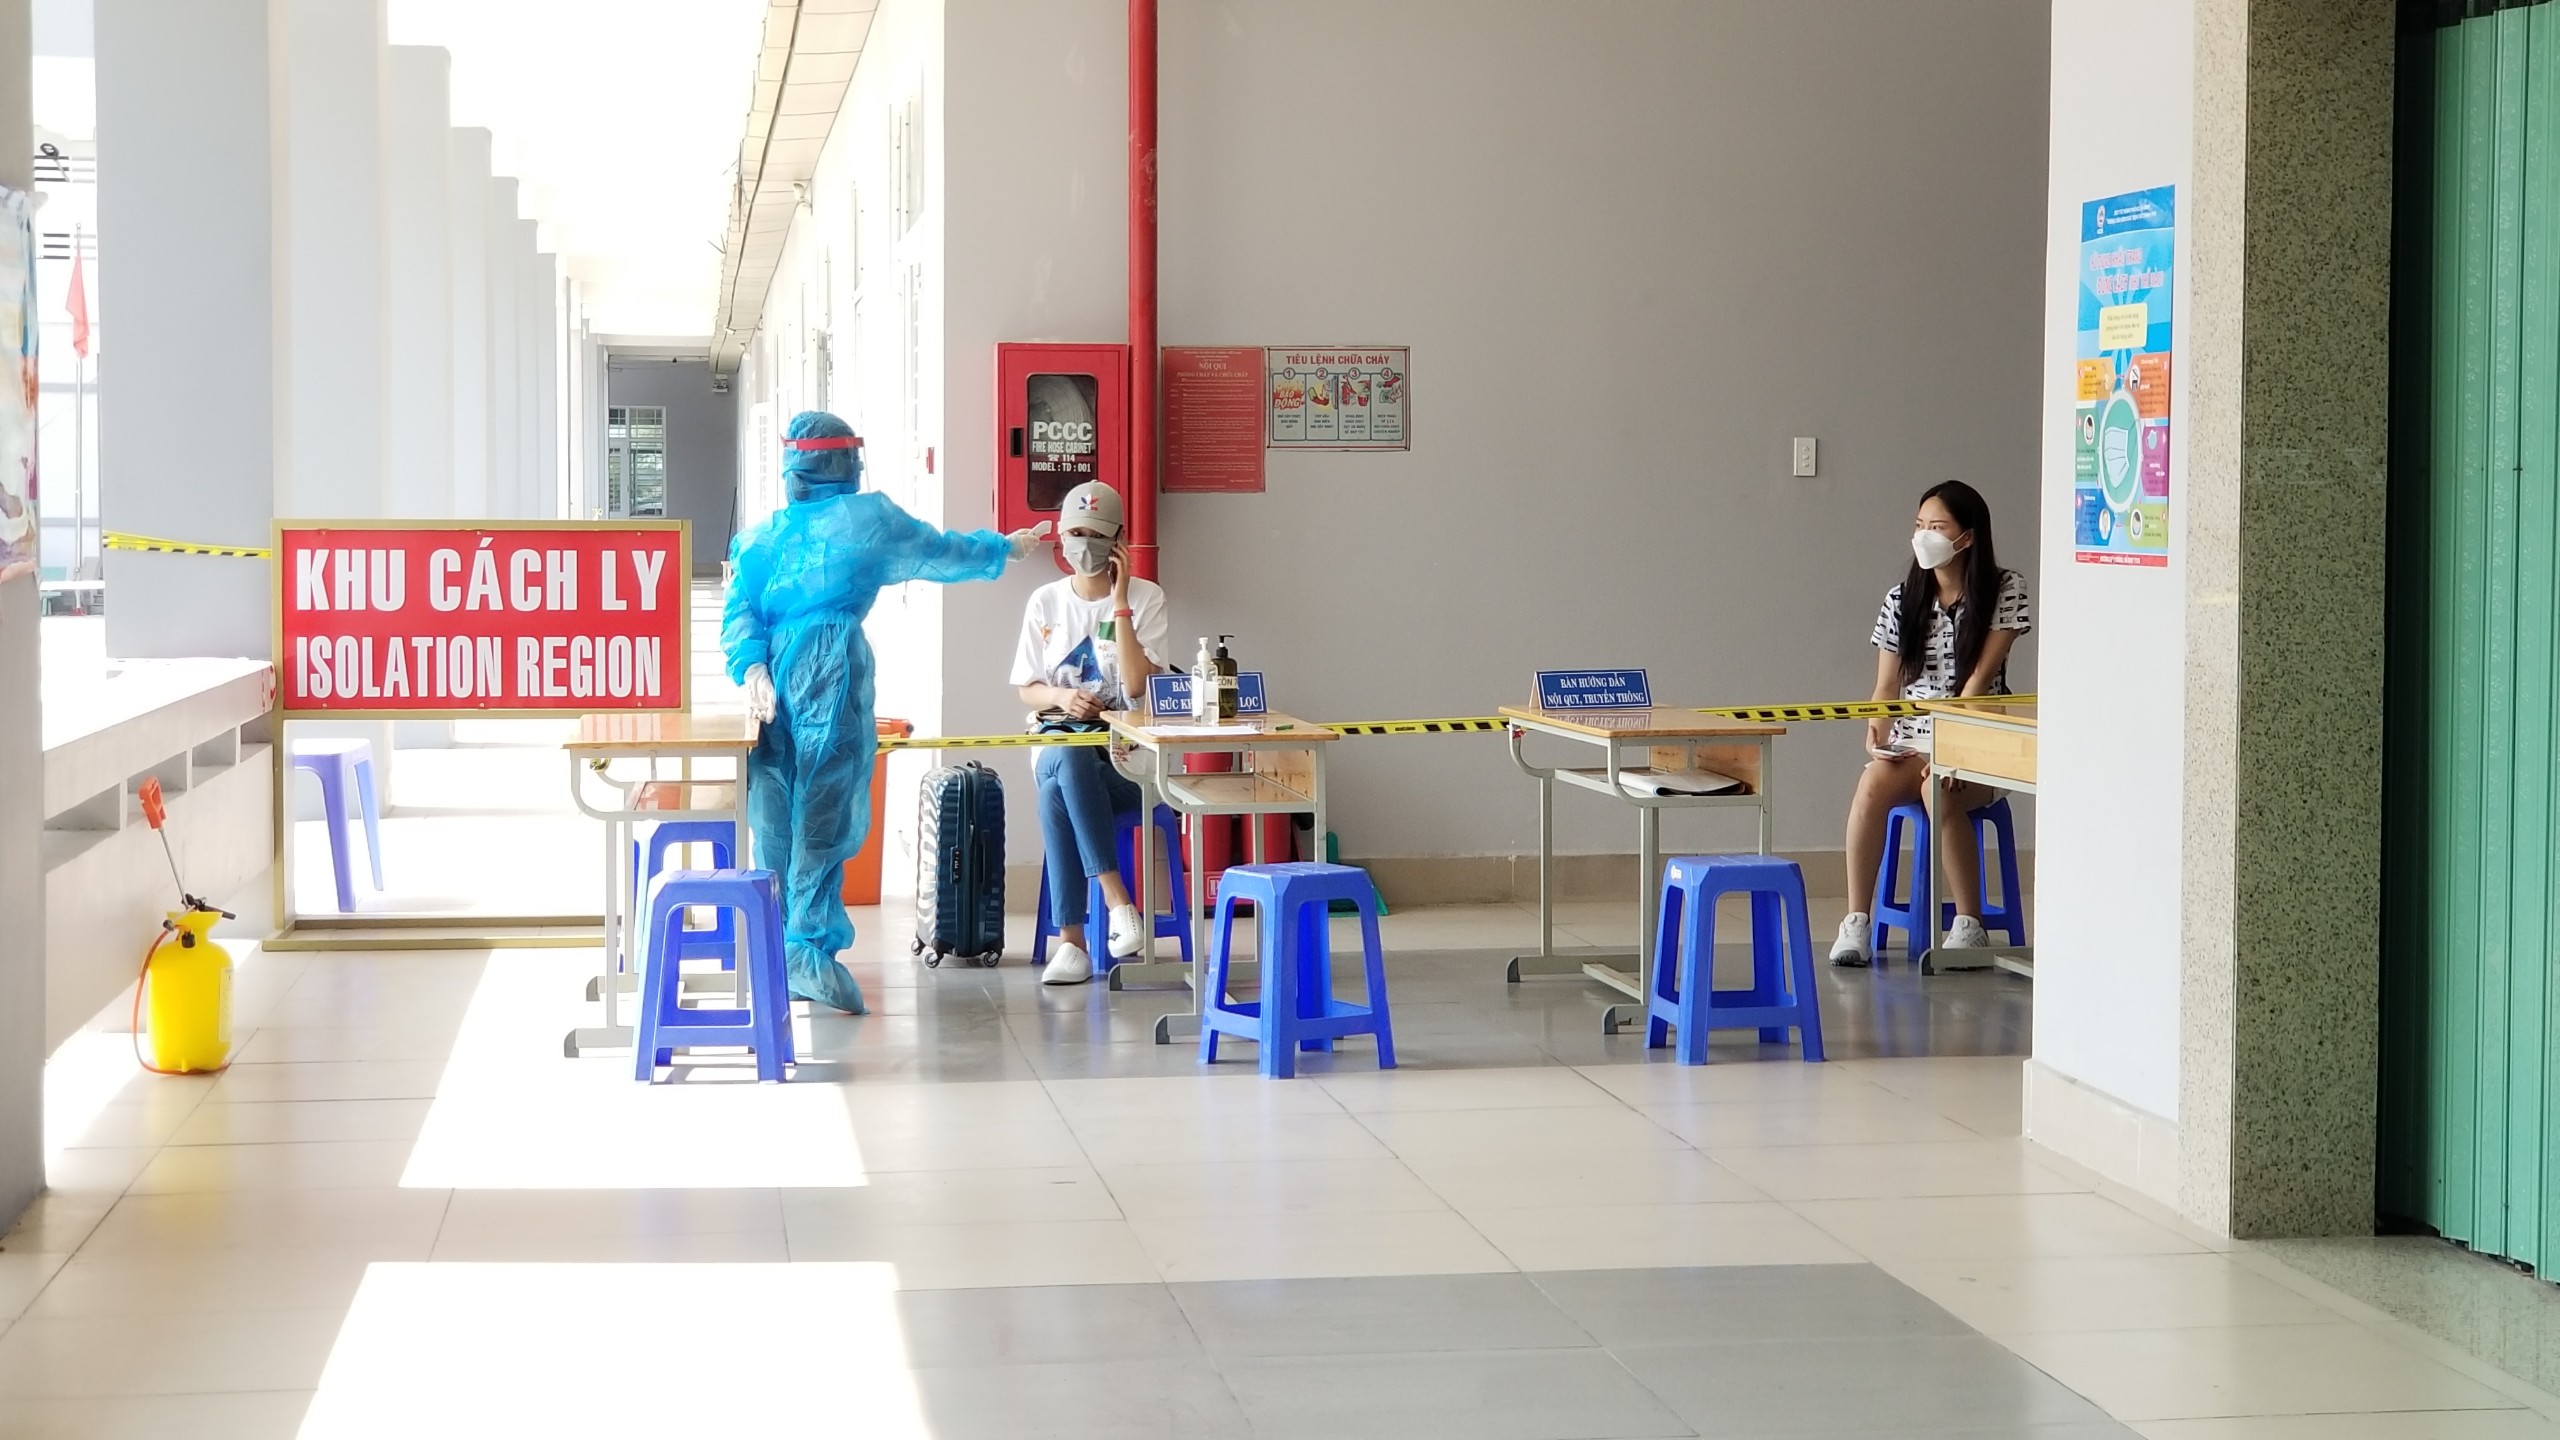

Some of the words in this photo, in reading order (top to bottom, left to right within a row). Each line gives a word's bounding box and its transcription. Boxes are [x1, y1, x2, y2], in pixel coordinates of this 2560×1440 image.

[1286, 353, 1307, 365] TIÊU
[1310, 353, 1335, 366] LỆNH
[1338, 353, 1363, 365] CHỮA
[1365, 353, 1390, 365] CHÁY
[1318, 370, 1325, 378] 2
[1351, 370, 1358, 378] 3
[1383, 370, 1389, 378] 4
[1033, 421, 1093, 441] PCCC
[1032, 441, 1046, 453] FIRE
[1047, 441, 1064, 453] HOSE
[1065, 442, 1092, 454] CABINET
[1062, 454, 1075, 462] 114
[1032, 462, 1056, 471] MODEL
[1062, 463, 1072, 472] TD
[1077, 463, 1091, 472] 001
[296, 549, 406, 611] KHU
[429, 537, 578, 611] CÁCH
[602, 550, 667, 611] LY
[296, 635, 502, 698] ISOLATION
[518, 635, 661, 698] REGION
[1172, 679, 1192, 692] BÀN
[1560, 676, 1578, 688] BÀN
[1240, 697, 1259, 709] LỌC
[1546, 692, 1562, 707] NỘI
[1563, 693, 1583, 706] QUY,
[1616, 690, 1645, 703] THÔNG
